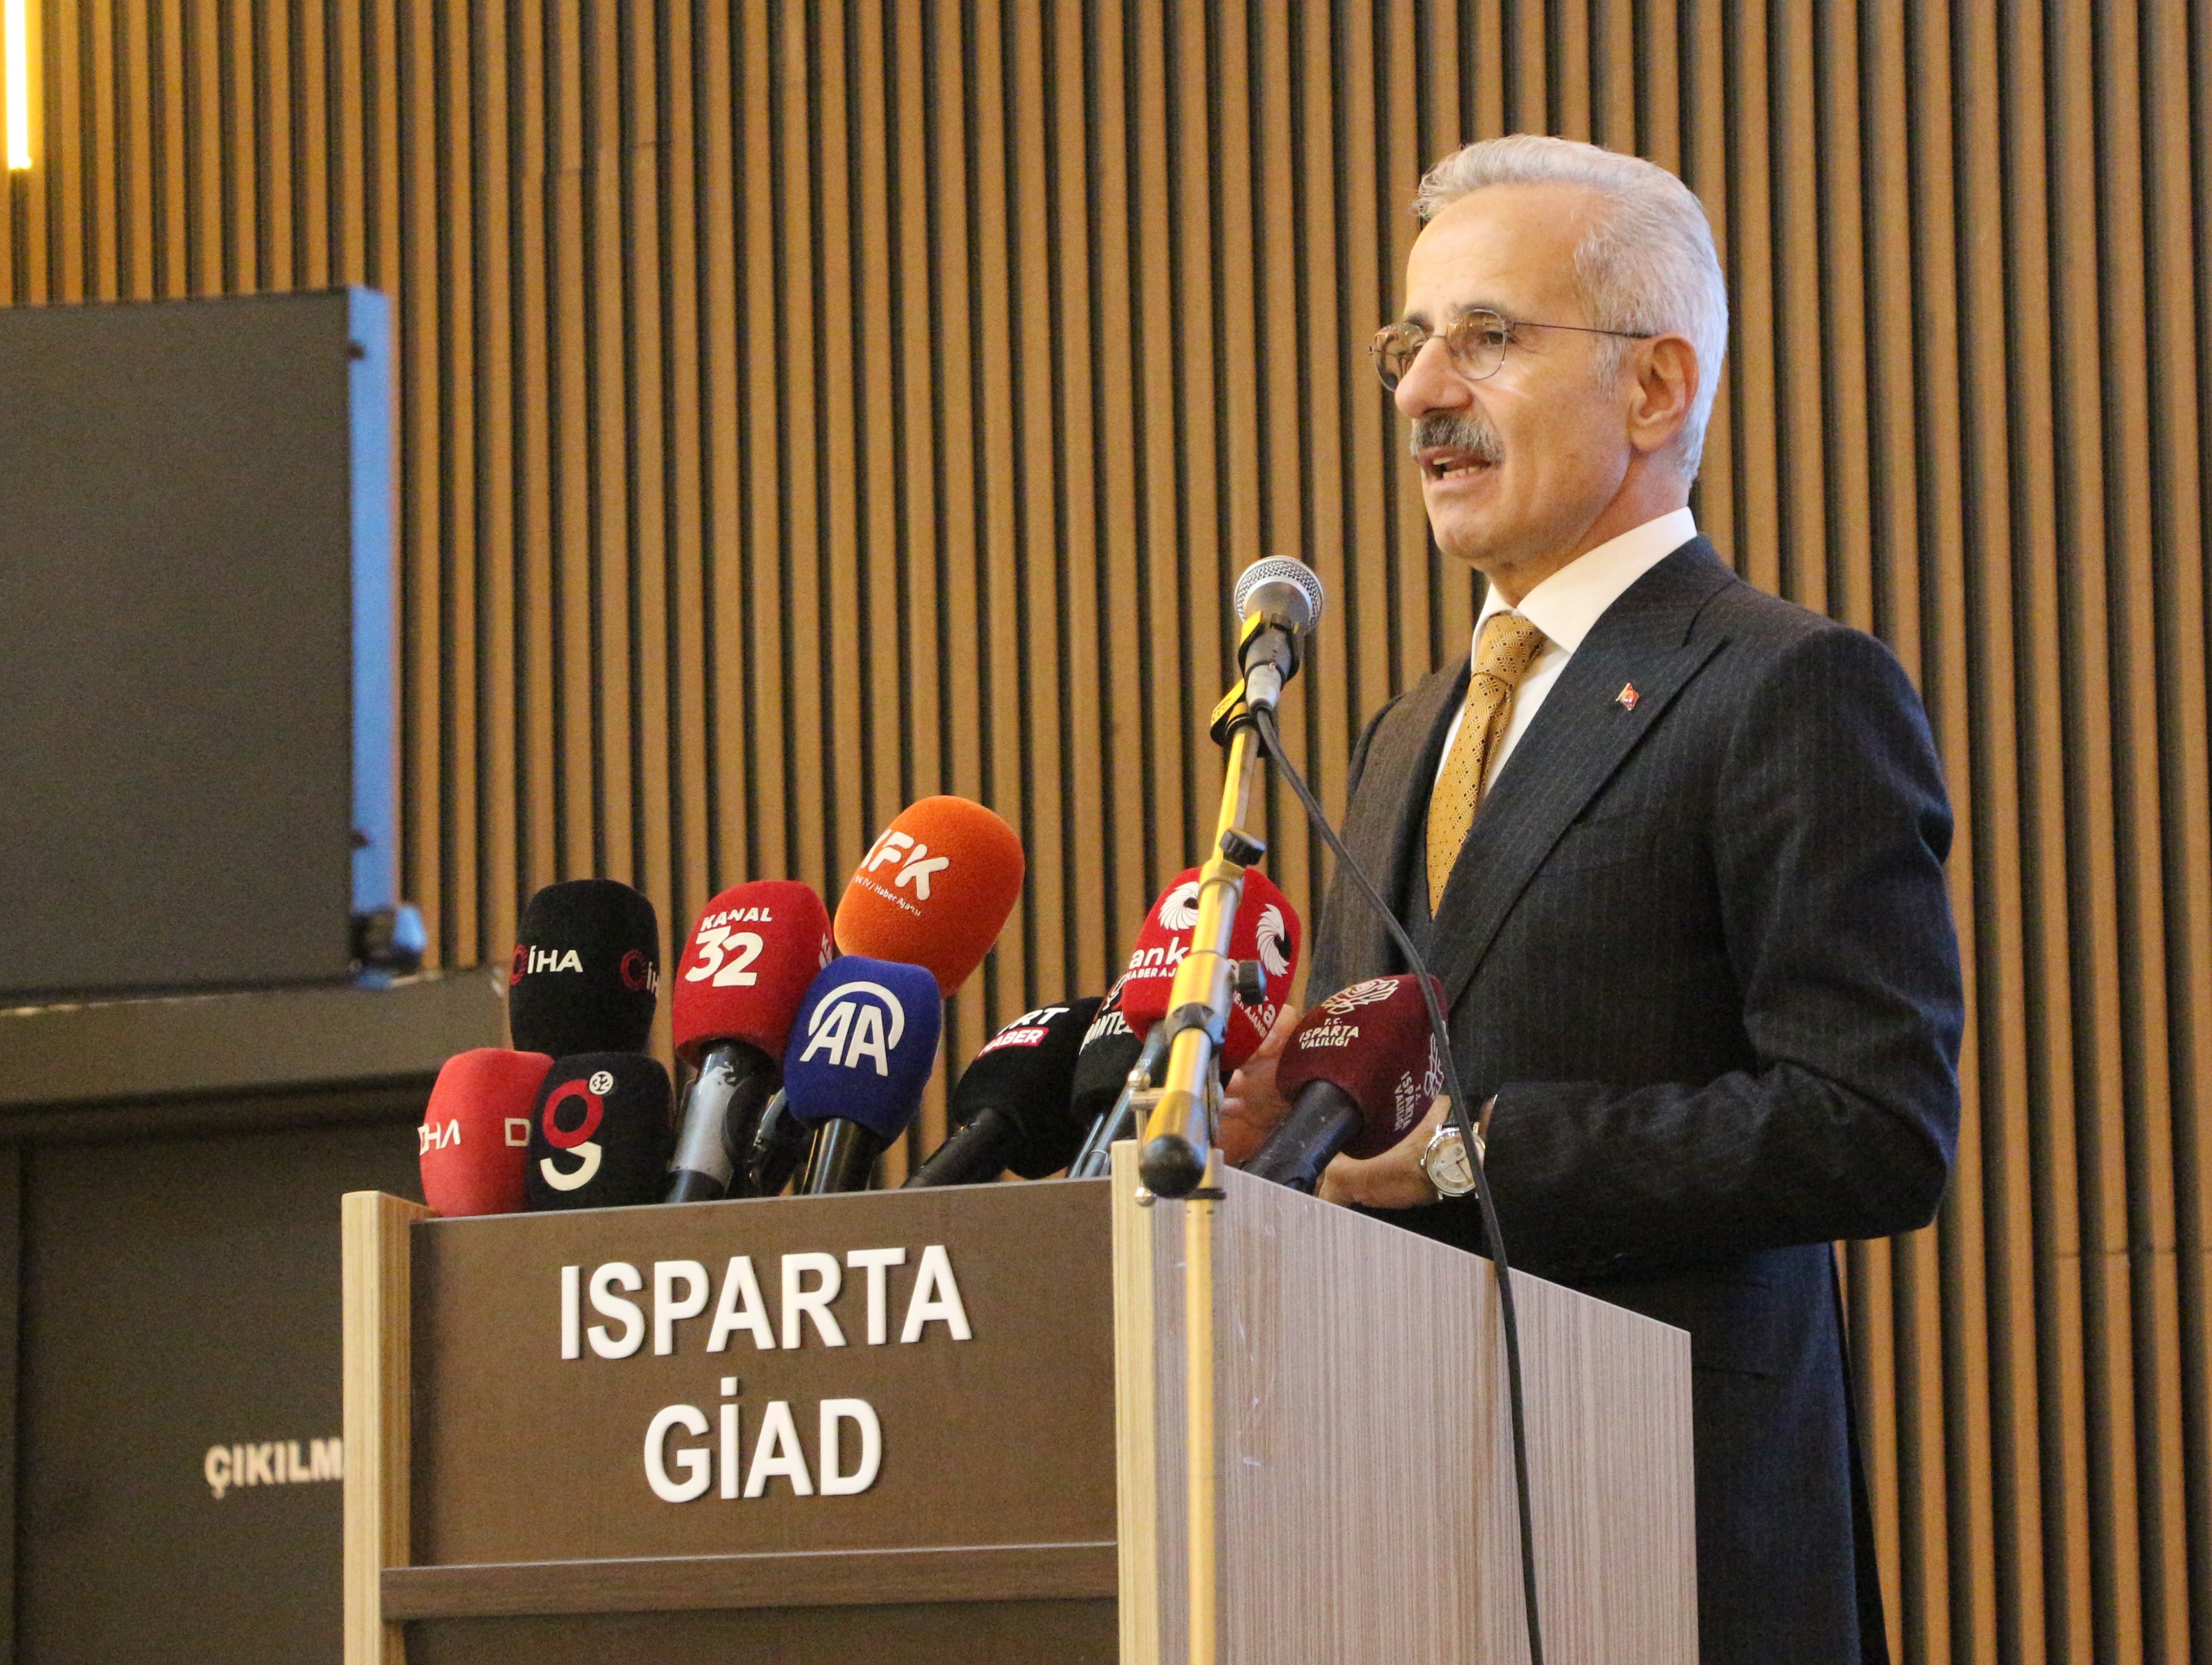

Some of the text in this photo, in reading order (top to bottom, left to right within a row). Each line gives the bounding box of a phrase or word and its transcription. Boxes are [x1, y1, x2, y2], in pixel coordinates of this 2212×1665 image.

[874, 885, 903, 902] Haber
[700, 907, 772, 932] KANAL
[685, 925, 763, 987] 32
[1129, 936, 1189, 970] ank
[800, 1001, 888, 1077] AA
[1299, 1025, 1360, 1043] ISPARTA
[592, 1074, 610, 1092] 32
[561, 1245, 972, 1360] ISPARTA
[644, 1376, 882, 1504] GİAD
[204, 1436, 343, 1500] ÇIKILM
